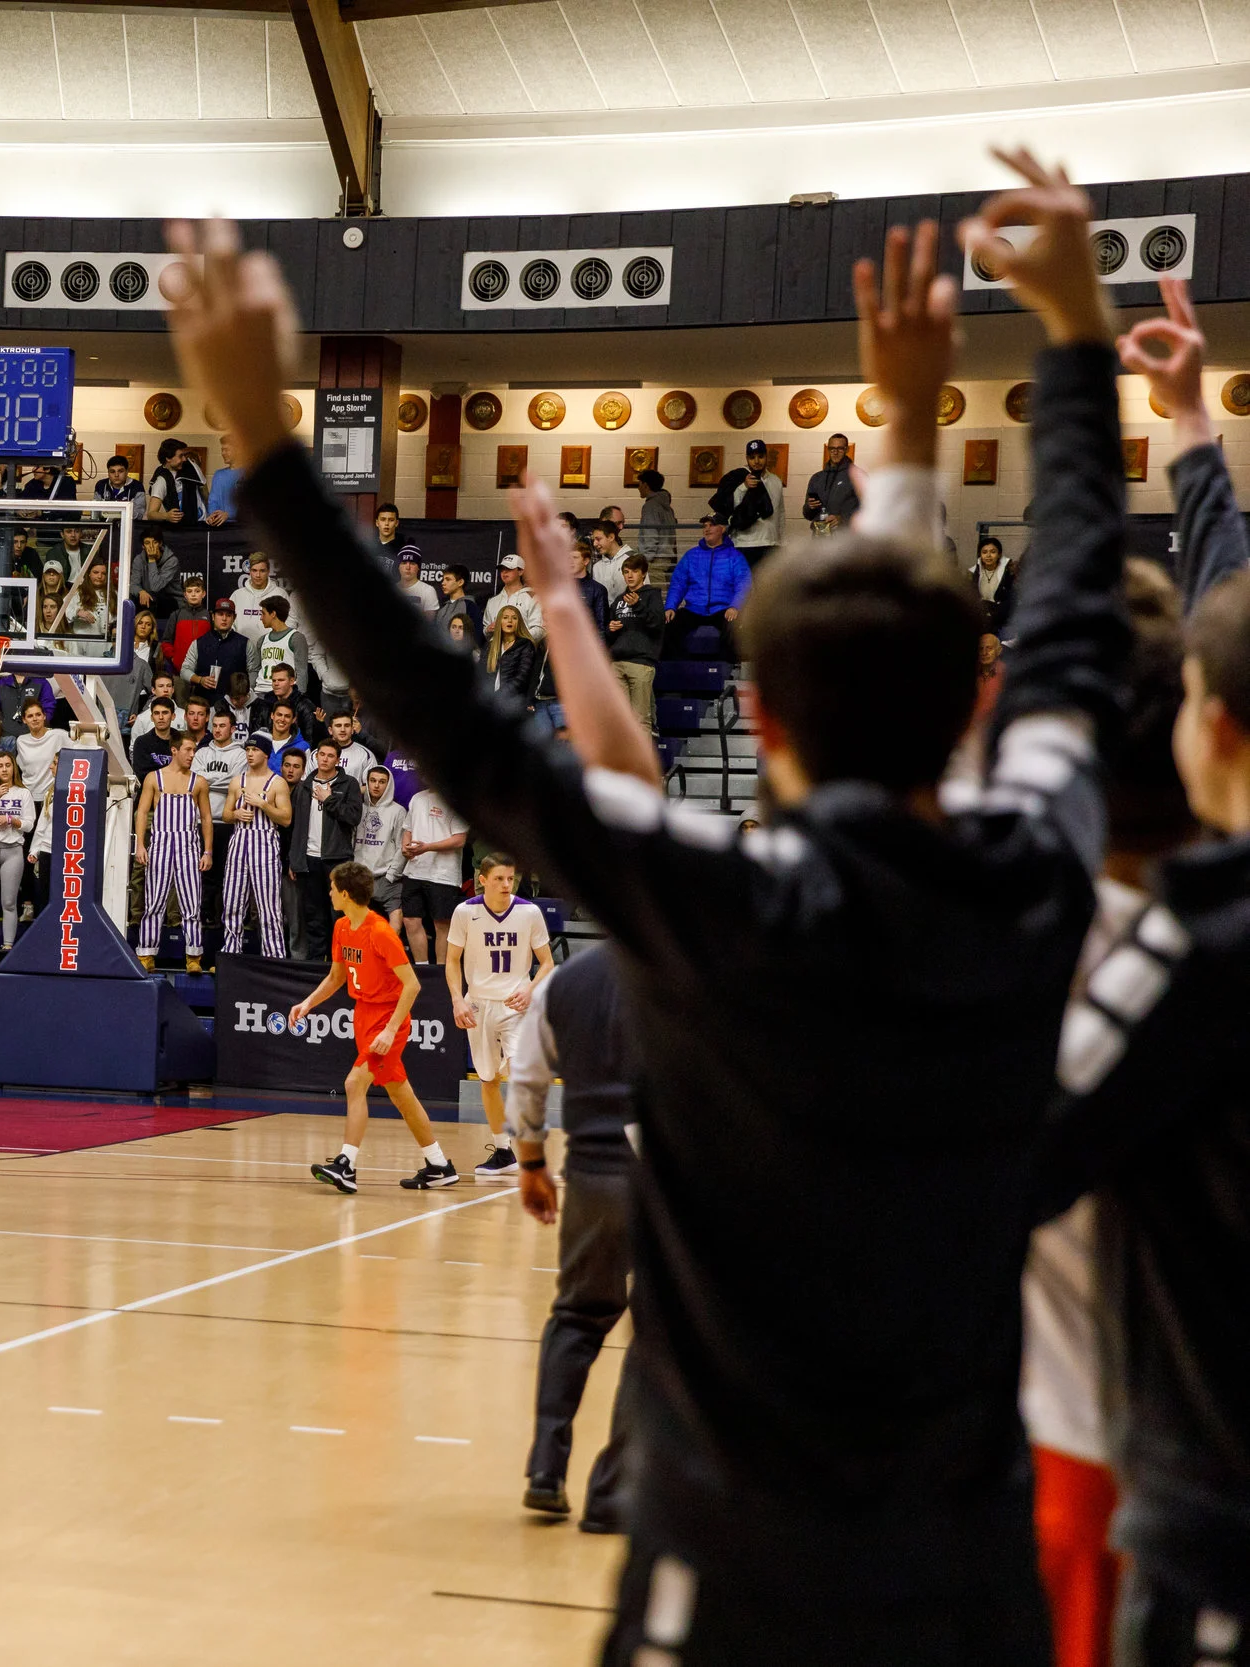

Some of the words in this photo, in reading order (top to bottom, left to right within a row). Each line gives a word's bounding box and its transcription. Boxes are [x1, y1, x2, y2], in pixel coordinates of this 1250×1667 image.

[326, 394, 341, 402] Find
[352, 394, 359, 402] in
[360, 394, 372, 402] the
[331, 404, 345, 412] App
[346, 404, 367, 412] Store!
[261, 647, 285, 661] BOSTON
[206, 760, 228, 773] IOWA
[60, 758, 91, 971] BROOKDALE
[483, 932, 517, 946] RFH
[490, 950, 511, 973] 11
